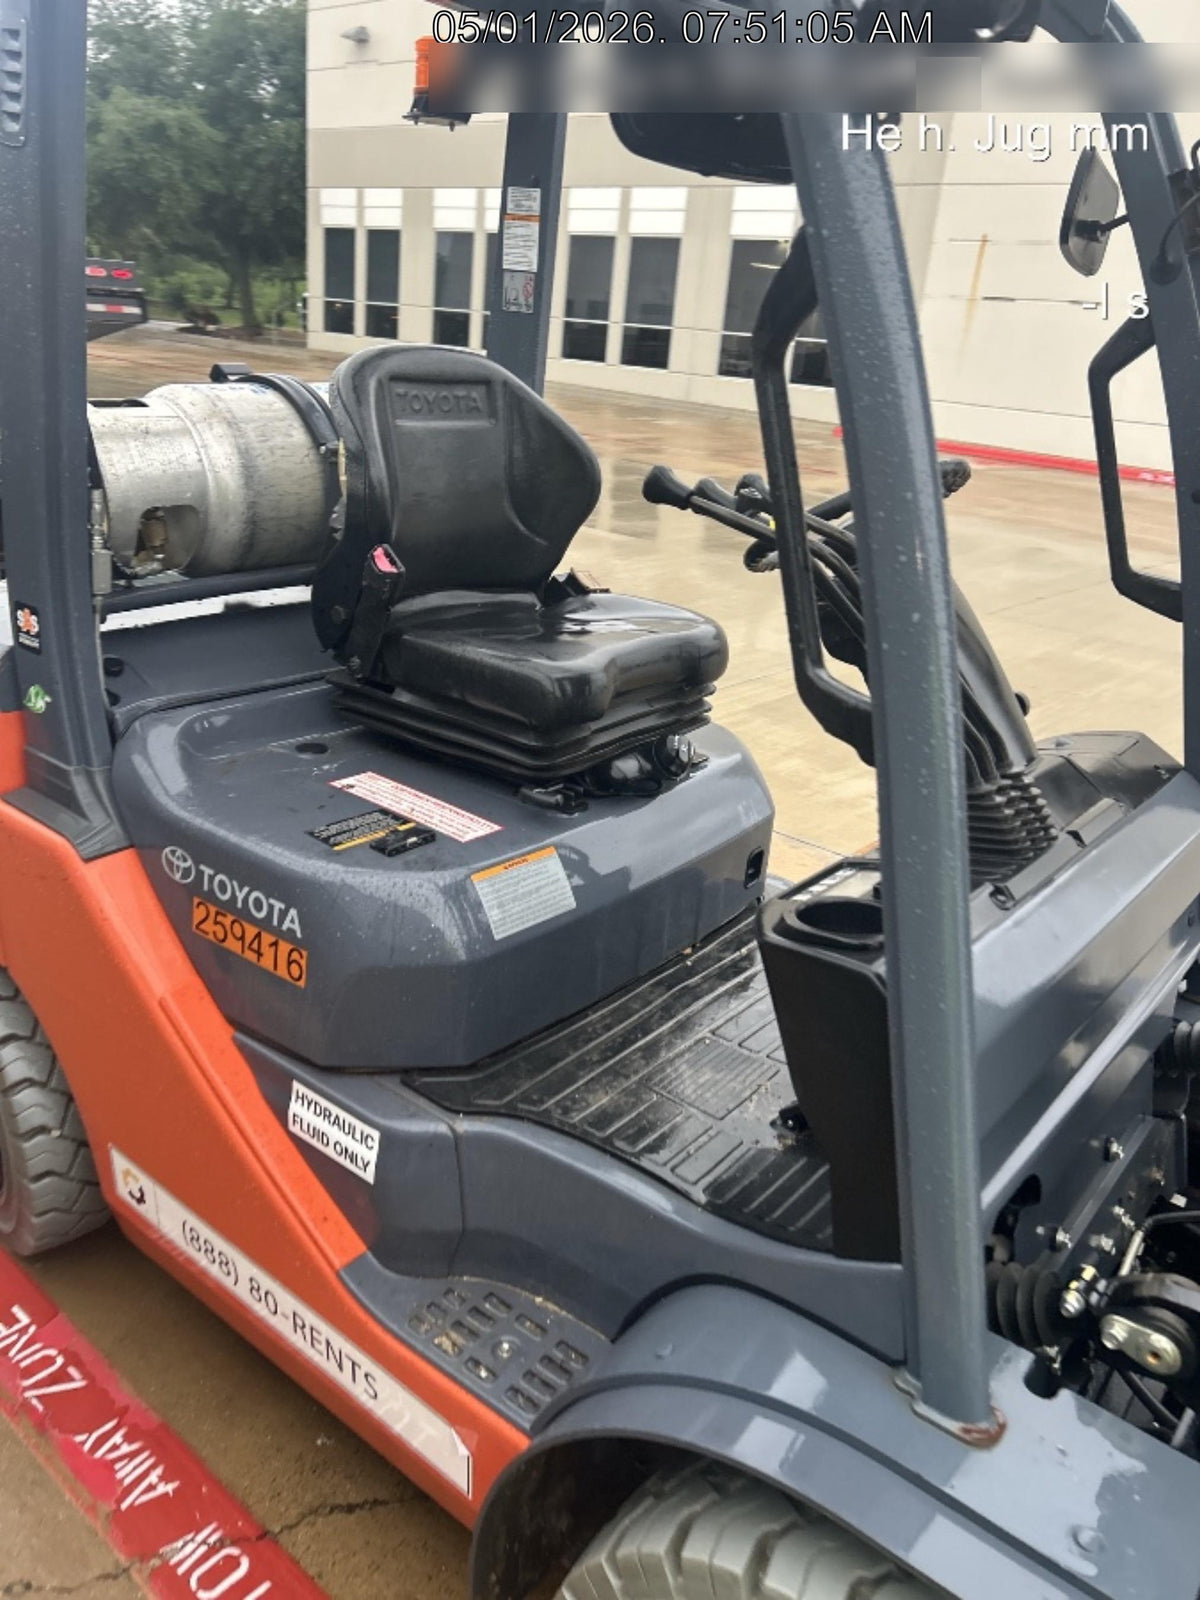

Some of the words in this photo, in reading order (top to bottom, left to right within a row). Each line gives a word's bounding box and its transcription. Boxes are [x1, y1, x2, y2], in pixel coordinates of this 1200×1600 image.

[394, 387, 482, 415] TOYOTA
[198, 863, 303, 939] TOYOTA
[194, 901, 304, 983] 259416
[292, 1112, 330, 1148] FLUID
[333, 1140, 371, 1174] ONLY
[294, 1088, 375, 1151] HYDRAULIC
[182, 1219, 240, 1288] (888)
[248, 1276, 379, 1401] 80-RENTS
